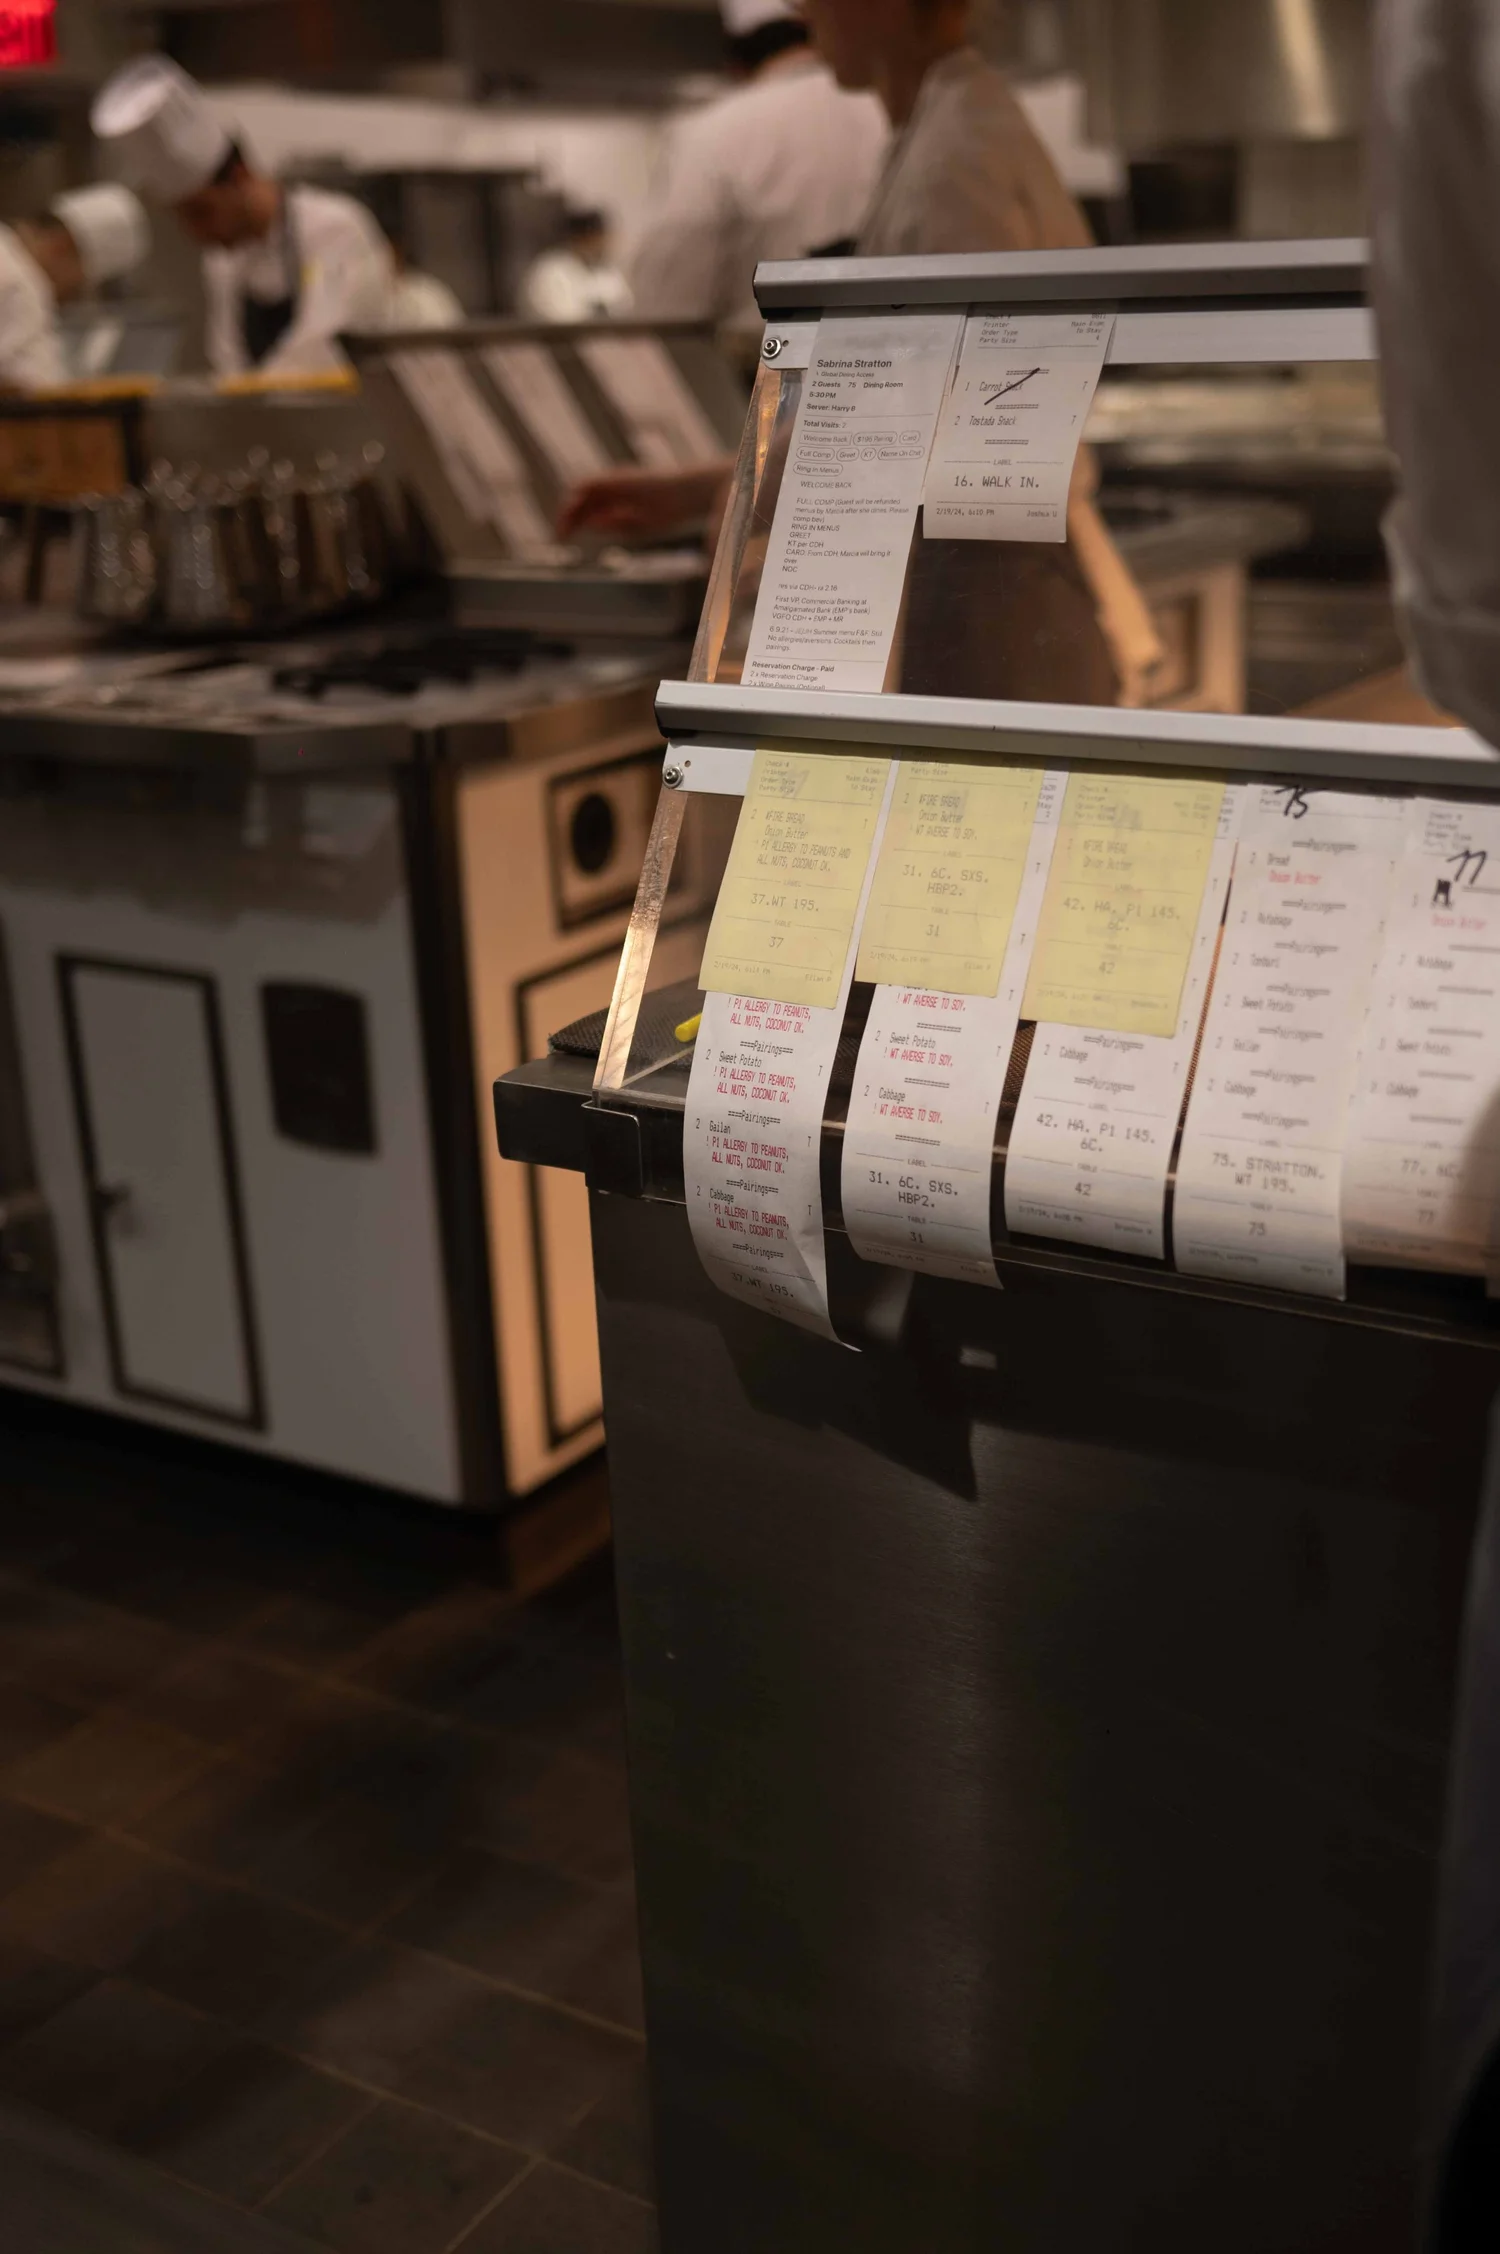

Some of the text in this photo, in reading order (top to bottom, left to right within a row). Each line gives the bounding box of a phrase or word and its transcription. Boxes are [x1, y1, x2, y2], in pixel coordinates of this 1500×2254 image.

[817, 360, 892, 368] Sabrina Stratton
[979, 382, 1001, 392] Carrot
[831, 404, 850, 412] Harry
[804, 420, 820, 428] Total
[954, 416, 1016, 426] 2 Tostada Snack
[804, 434, 832, 442] Welcome
[796, 464, 811, 472] Ring
[954, 476, 1040, 488] 16. WALK IN.
[936, 508, 964, 516] 2/19/24,
[837, 598, 860, 606] Banking
[816, 606, 830, 614] Bank
[752, 661, 790, 670] Reservation
[792, 664, 815, 672] Charge
[760, 672, 795, 680] Reservation
[786, 812, 806, 824] BREAD
[927, 826, 950, 838] AVERSE
[771, 840, 837, 858] ALLERGY PEANUTS
[757, 854, 818, 870] ALL COCONUT
[902, 864, 988, 883] 31. 6C. SXS.
[927, 882, 962, 896] HBP2.
[751, 893, 820, 912] 37.WT 195.
[926, 924, 940, 937] 31
[768, 936, 784, 948] 37
[1099, 962, 1116, 974] 42
[903, 994, 966, 1012] WT AVERSE TO SOY.
[744, 1000, 811, 1021] ALLERGY TO PEANUTS,
[730, 1013, 804, 1034] ALL NUTS, COCONUT OK.
[874, 1030, 936, 1048] 2 Sweet Potato
[706, 1049, 762, 1068] 2 Sweet Potato
[890, 1048, 952, 1067] WT AVERSE TO SOY.
[1059, 1046, 1088, 1063] Cabbage
[730, 1069, 796, 1090] ALLERGY TO PEANUTS,
[717, 1082, 790, 1104] ALL NUTS, COCONUT OK.
[864, 1085, 906, 1104] 2 Cabbage
[880, 1104, 942, 1124] WT AVERSE TO SOY.
[710, 1120, 731, 1134] Gailan
[1037, 1114, 1156, 1144] 42. HA. P1 145.
[723, 1138, 789, 1162] ALLERGY TO PEANUTS,
[1080, 1138, 1103, 1152] 6C.
[712, 1152, 786, 1174] ALL NUTS, COCONUT OK.
[869, 1171, 958, 1196] 31. 6C. SXS.
[1075, 1182, 1092, 1196] 42
[710, 1188, 734, 1204] Cabbage
[898, 1192, 935, 1208] HBP2.
[724, 1205, 790, 1229] ALLERGY TO PEANUTS,
[716, 1218, 775, 1238] ALL NUTS, COCONUT
[1249, 1222, 1266, 1236] 75
[910, 1232, 924, 1244] 31
